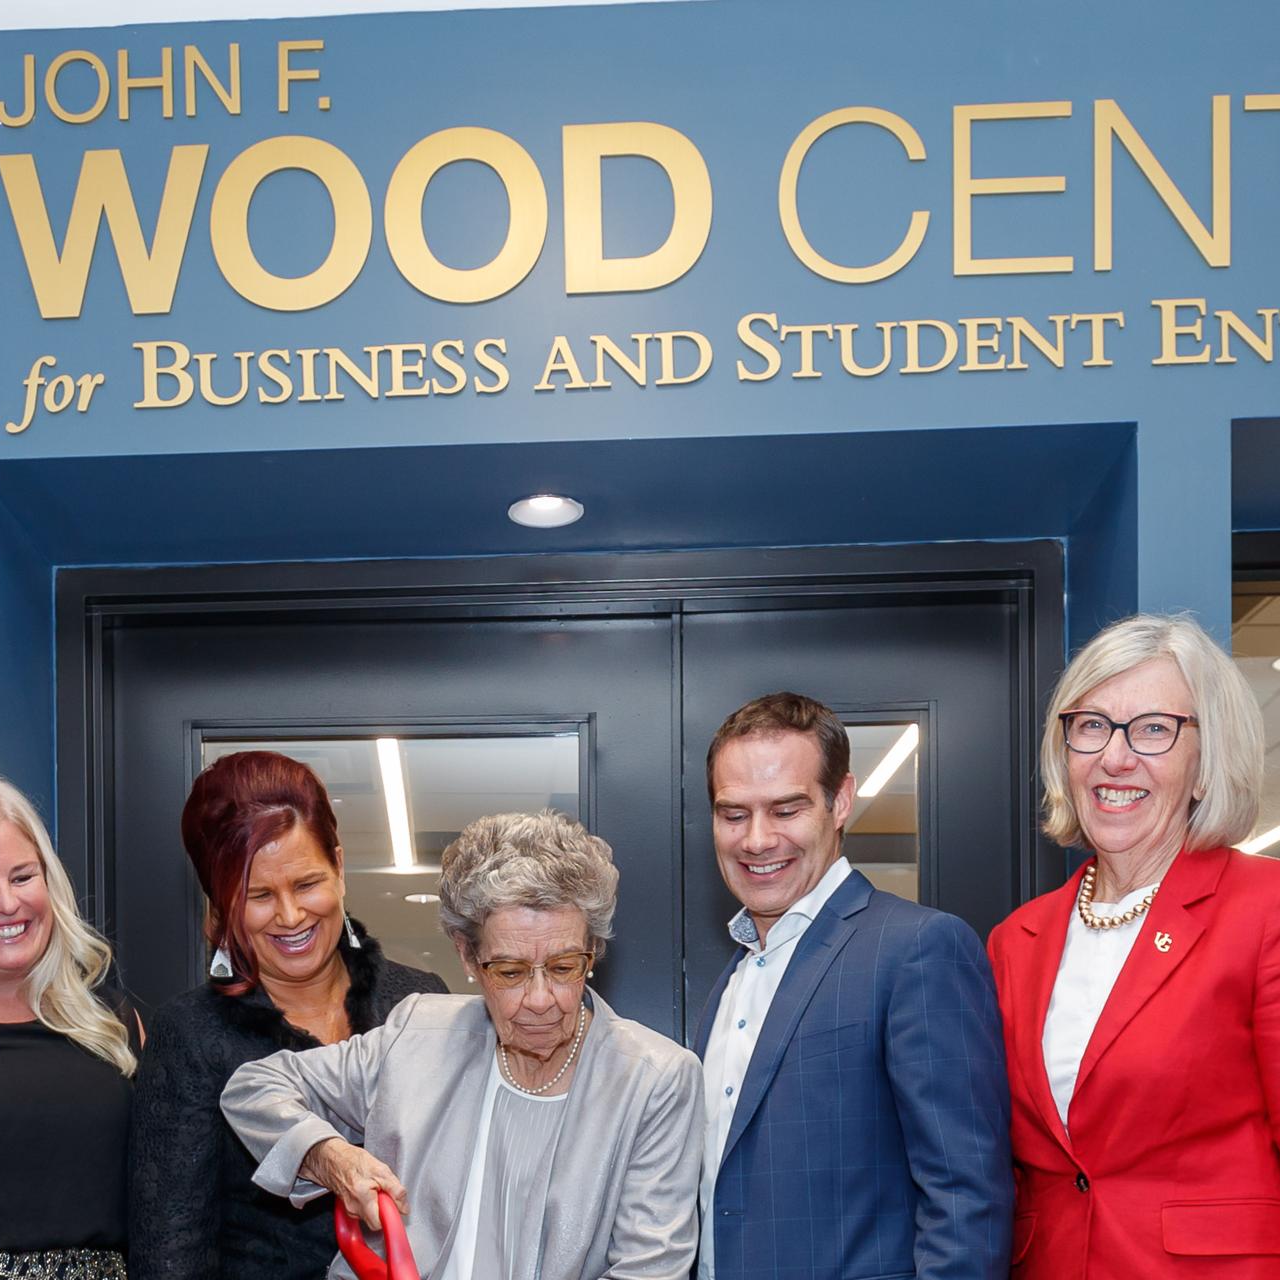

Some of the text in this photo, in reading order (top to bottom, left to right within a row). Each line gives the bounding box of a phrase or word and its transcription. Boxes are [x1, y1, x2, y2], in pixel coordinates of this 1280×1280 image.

[278, 40, 331, 112] F.
[5, 355, 105, 433] for
[133, 338, 510, 409] BUSINESS
[534, 330, 713, 391] AND
[736, 311, 1125, 381] STUDENT
